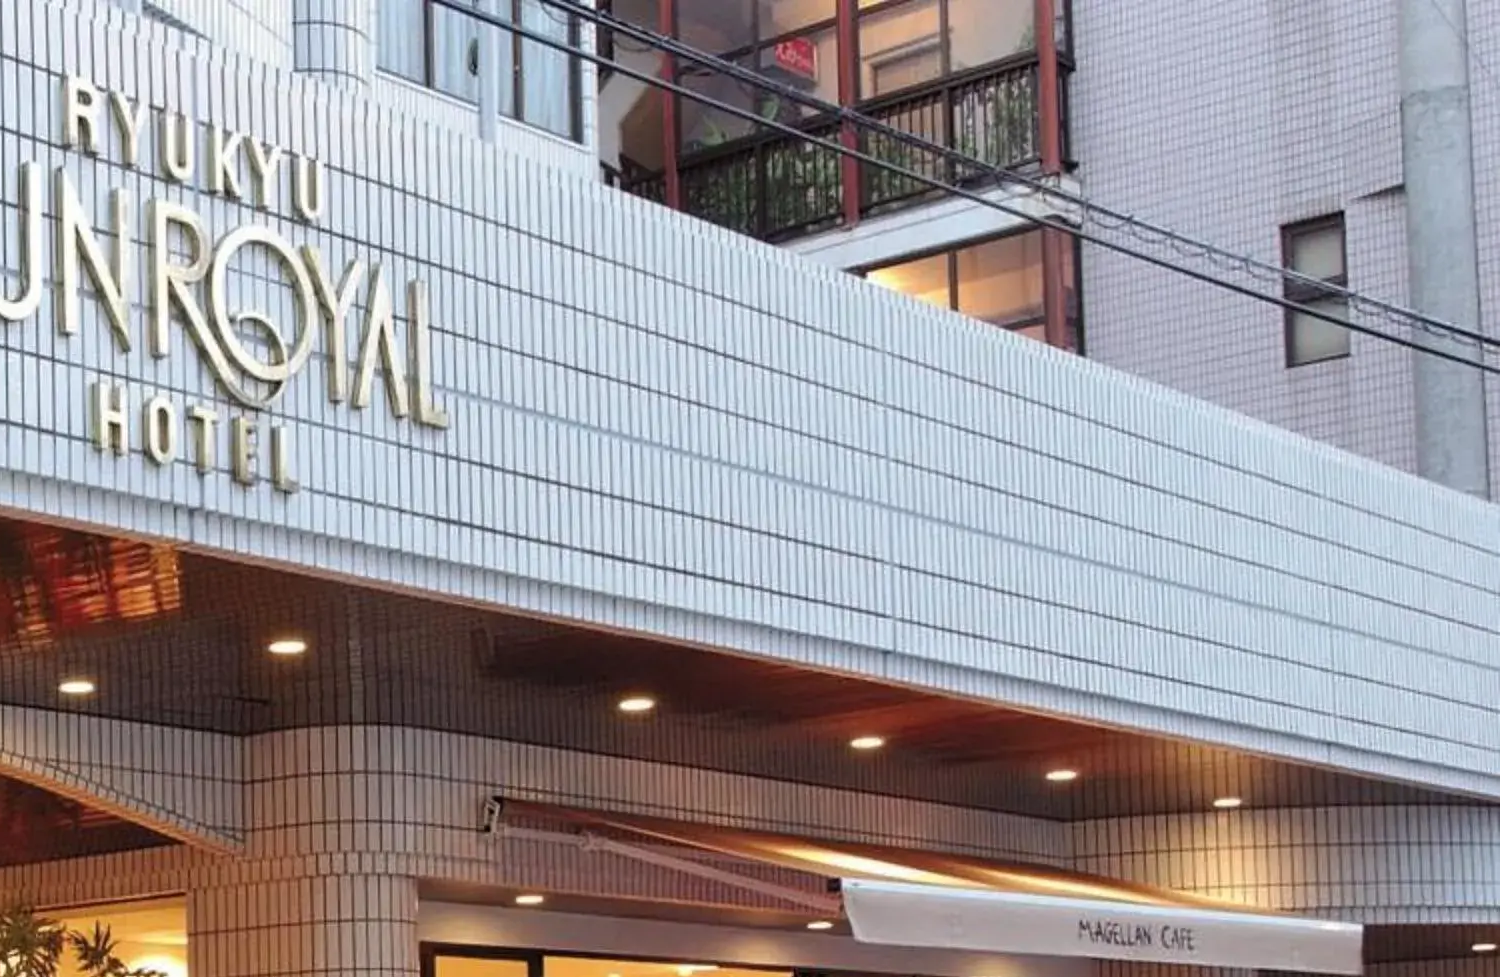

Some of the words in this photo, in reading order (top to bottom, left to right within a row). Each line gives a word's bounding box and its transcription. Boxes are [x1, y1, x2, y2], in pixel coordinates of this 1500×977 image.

[61, 74, 326, 225] RYUKYU
[92, 380, 299, 494] HOTEL
[1078, 918, 1153, 947] MAGELLAN
[1160, 924, 1195, 951] CAFE
